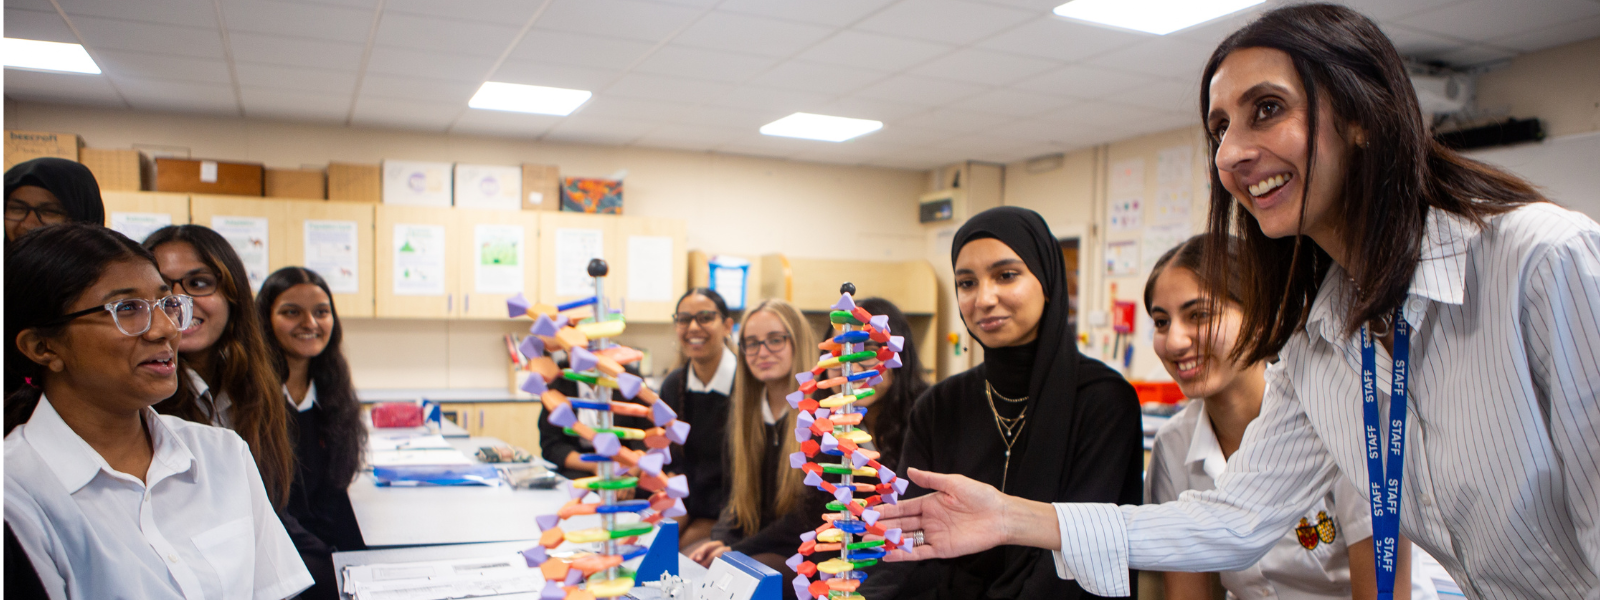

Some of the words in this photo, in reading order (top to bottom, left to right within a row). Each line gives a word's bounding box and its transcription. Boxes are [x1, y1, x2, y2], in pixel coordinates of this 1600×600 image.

[1364, 369, 1374, 403] STAFF
[1394, 359, 1405, 396] STAFF
[1367, 425, 1378, 459] STAFF
[1391, 419, 1402, 456] STAFF
[1371, 482, 1383, 517] STAFF
[1386, 478, 1398, 515] STAFF
[1382, 537, 1395, 573] STAFF
